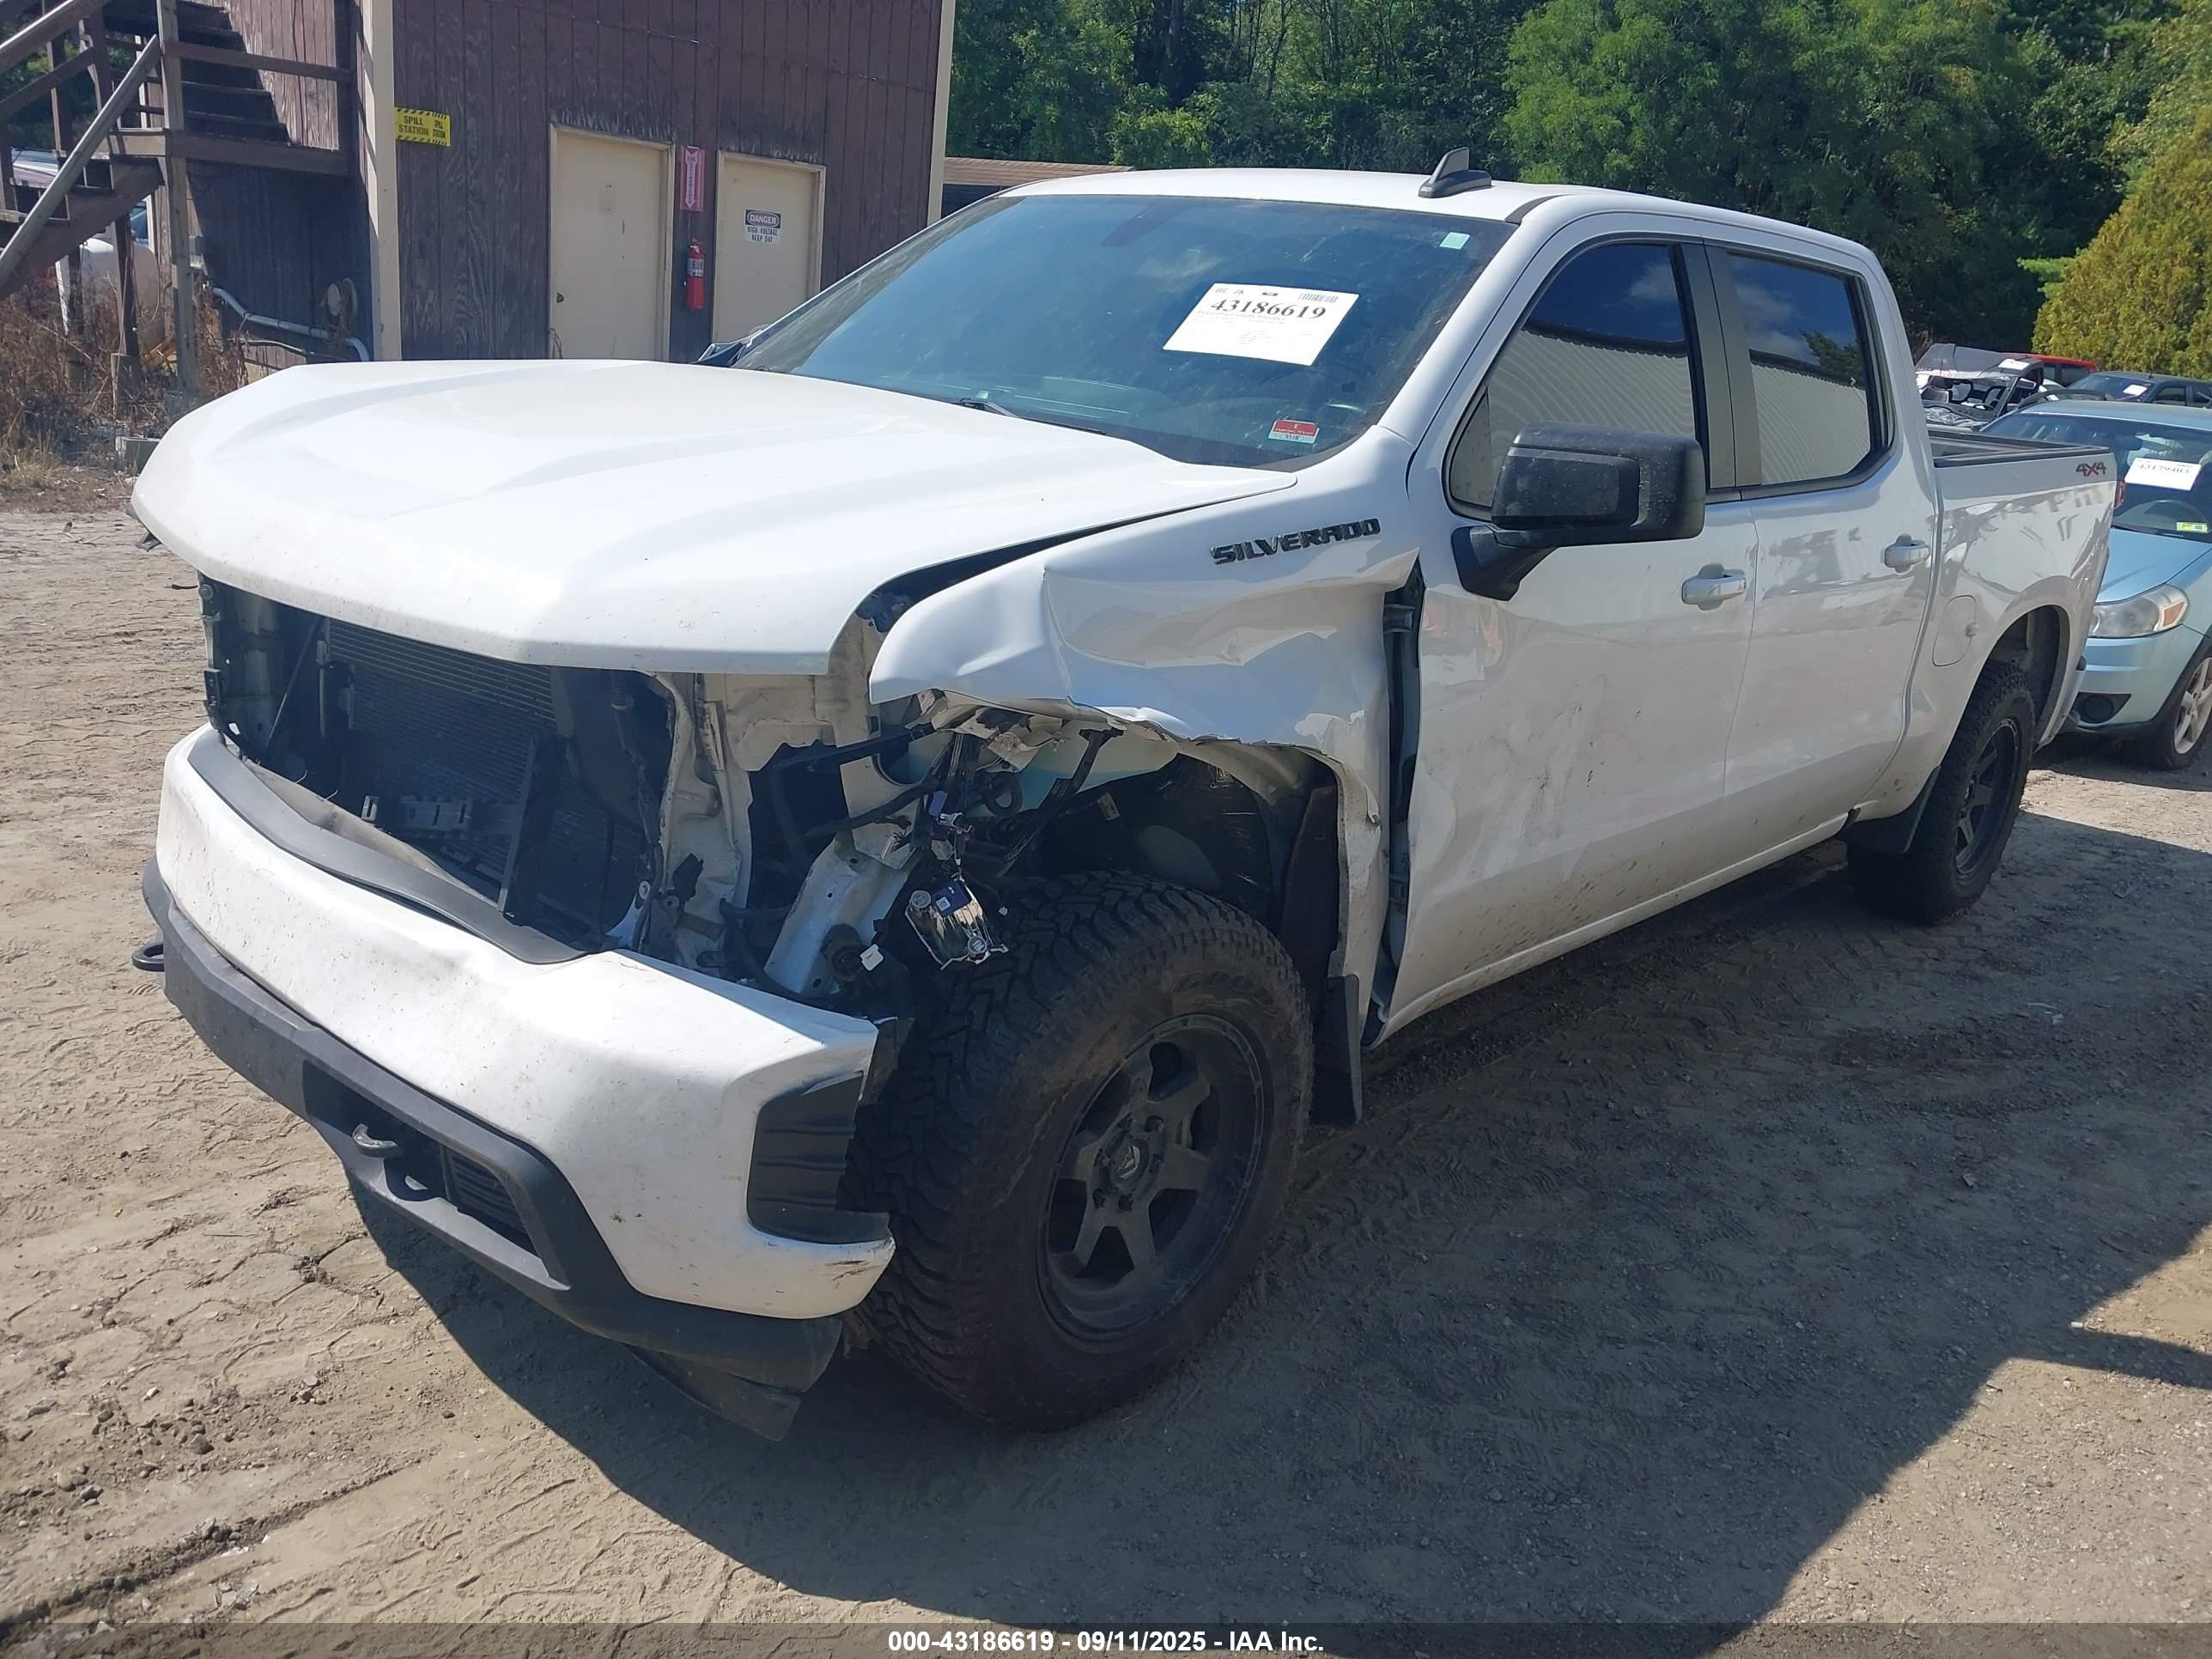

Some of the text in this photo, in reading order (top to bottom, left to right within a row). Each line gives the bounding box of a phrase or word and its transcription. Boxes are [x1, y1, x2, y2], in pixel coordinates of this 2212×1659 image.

[404, 116, 423, 125] SPILL
[398, 125, 428, 136] STATION
[750, 214, 777, 225] DANGER
[760, 228, 778, 236] VOLTAGE
[1211, 298, 1327, 319] 43186619
[1210, 517, 1382, 565] SILVERADO
